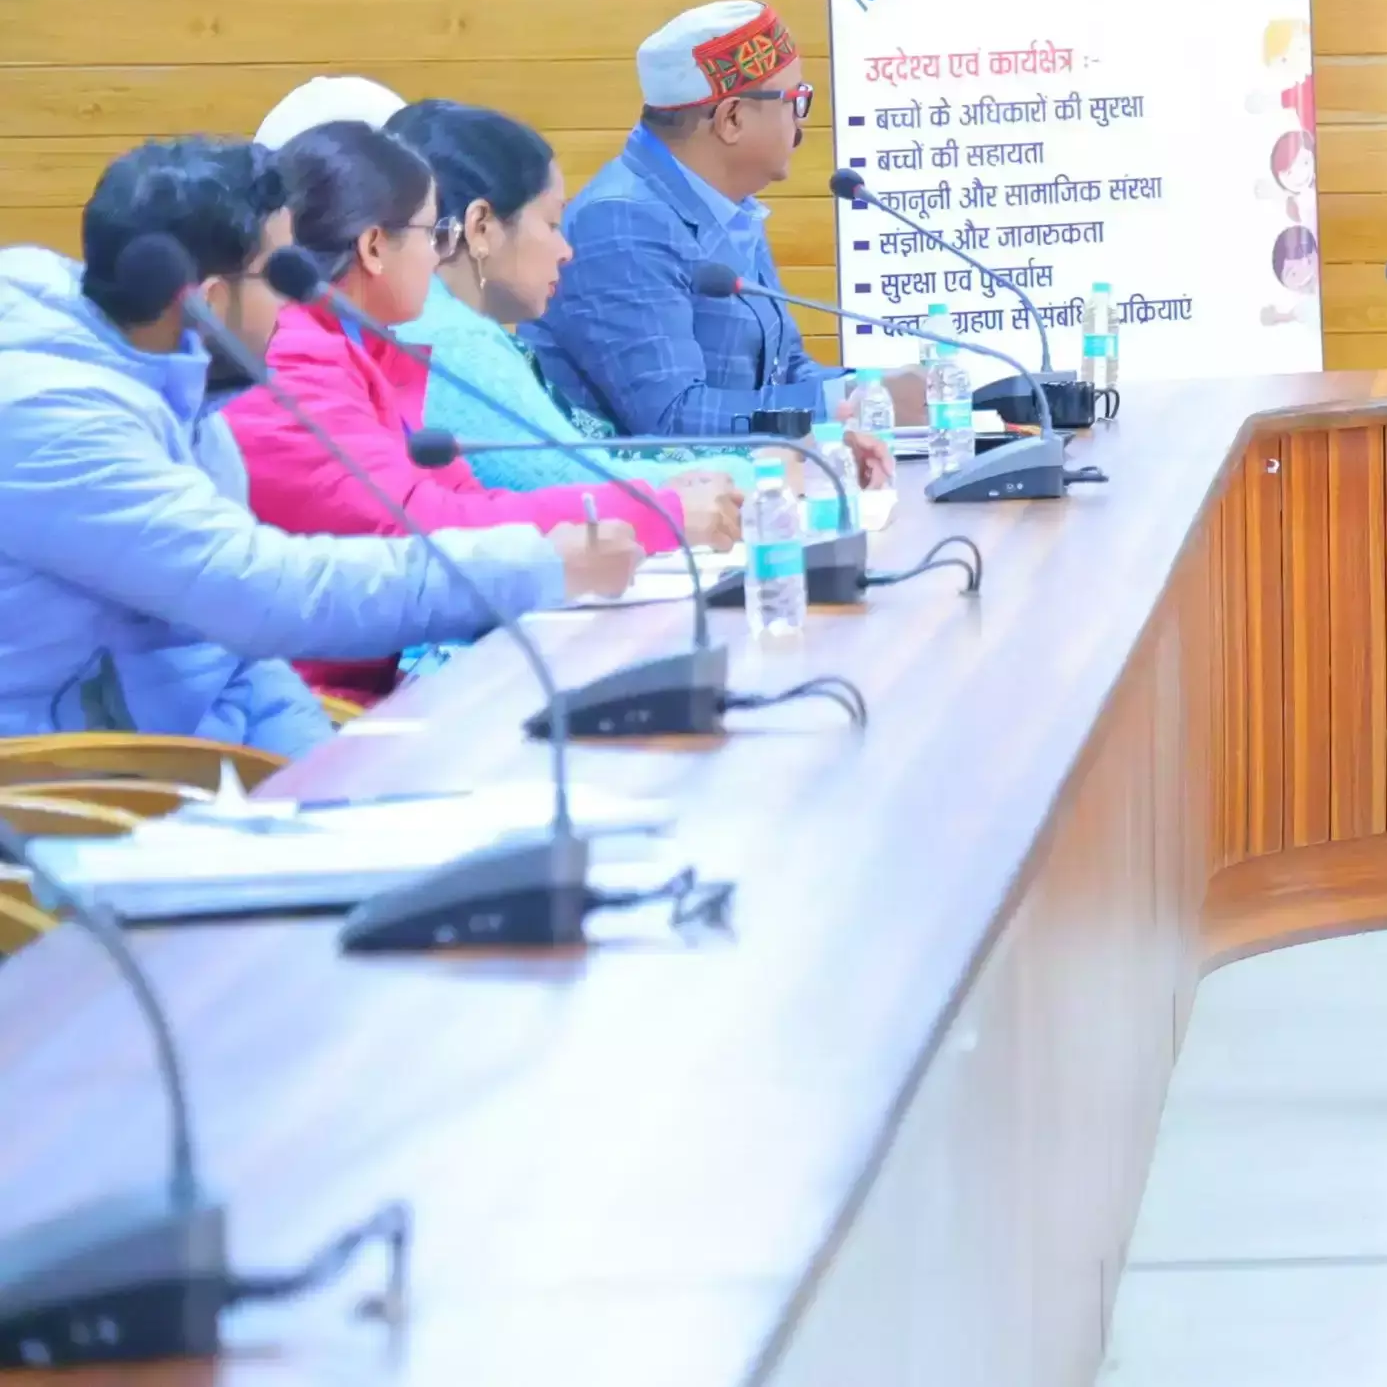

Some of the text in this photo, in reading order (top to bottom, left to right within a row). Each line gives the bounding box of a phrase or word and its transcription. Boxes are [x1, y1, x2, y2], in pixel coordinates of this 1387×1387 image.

[947, 47, 981, 79] एवं
[987, 39, 1074, 76] कार्यक्षेत्र
[875, 91, 1145, 131] बच्चों के अधिकारों की सुरक्षा
[876, 138, 1045, 171] बच्चों की सहायता
[877, 173, 1163, 219] कानूनी और सामाजिक संरक्षा
[952, 218, 991, 250] और
[996, 220, 1105, 248] जागरुकता
[880, 271, 937, 304] सुरक्षा
[979, 257, 1053, 299] पुनर्वास
[881, 314, 930, 338] दत्त
[950, 309, 1004, 335] ग्रहण
[1036, 296, 1086, 328] संबंधि
